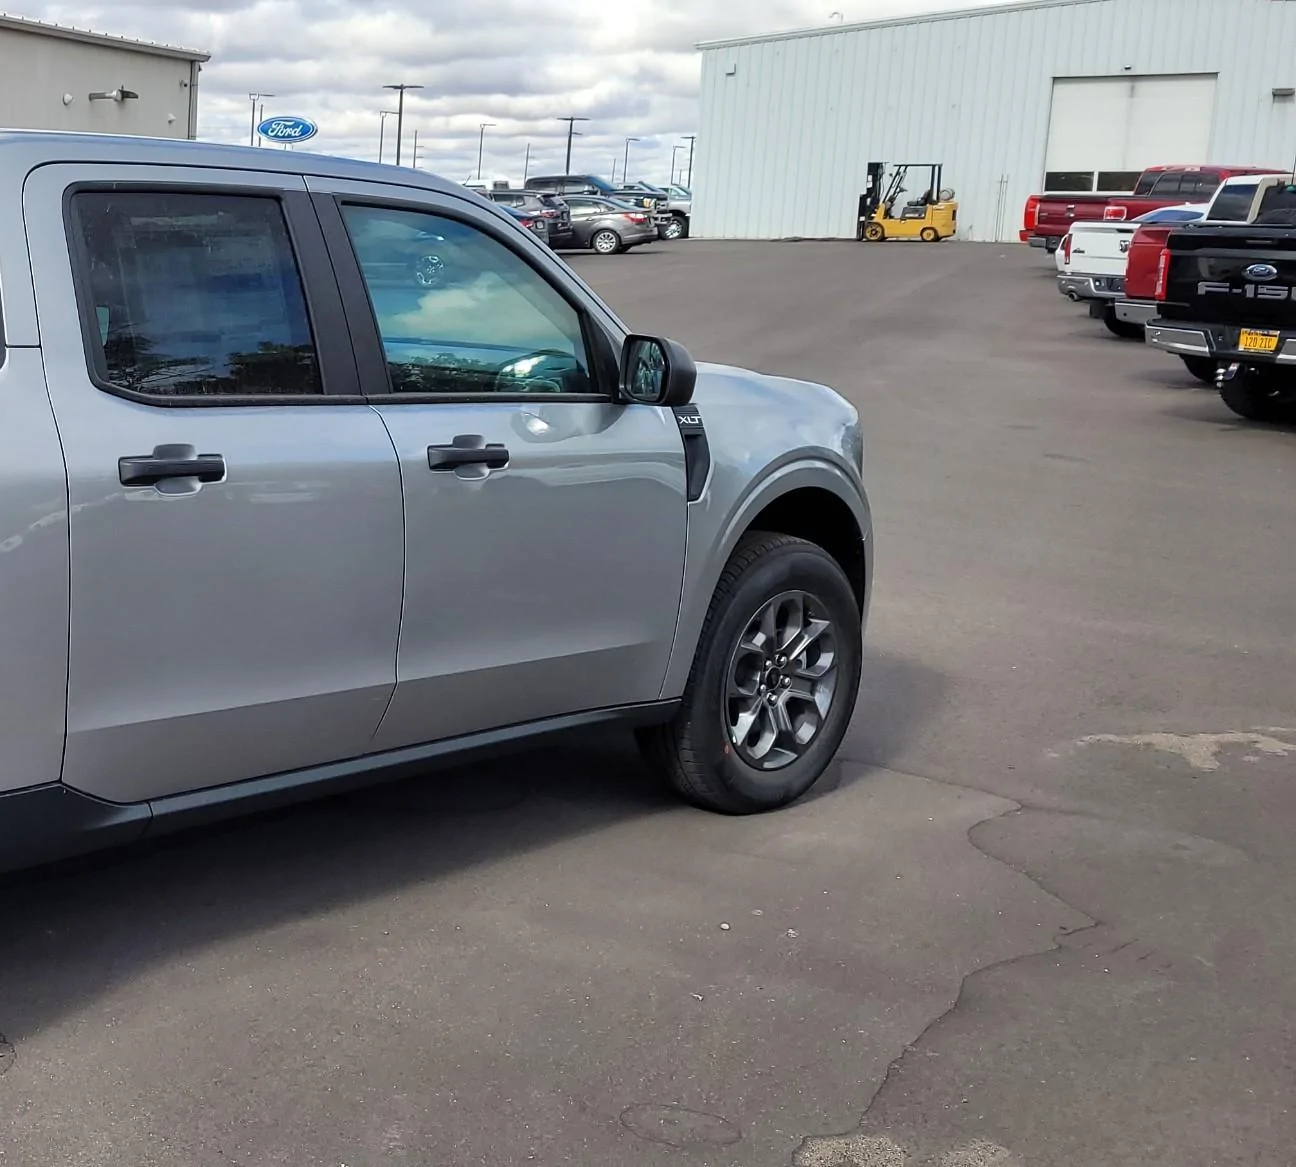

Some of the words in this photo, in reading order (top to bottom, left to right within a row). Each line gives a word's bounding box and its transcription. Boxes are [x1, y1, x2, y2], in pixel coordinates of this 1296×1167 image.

[267, 120, 304, 137] Ford
[1197, 281, 1296, 301] F-15
[677, 415, 702, 424] XLT
